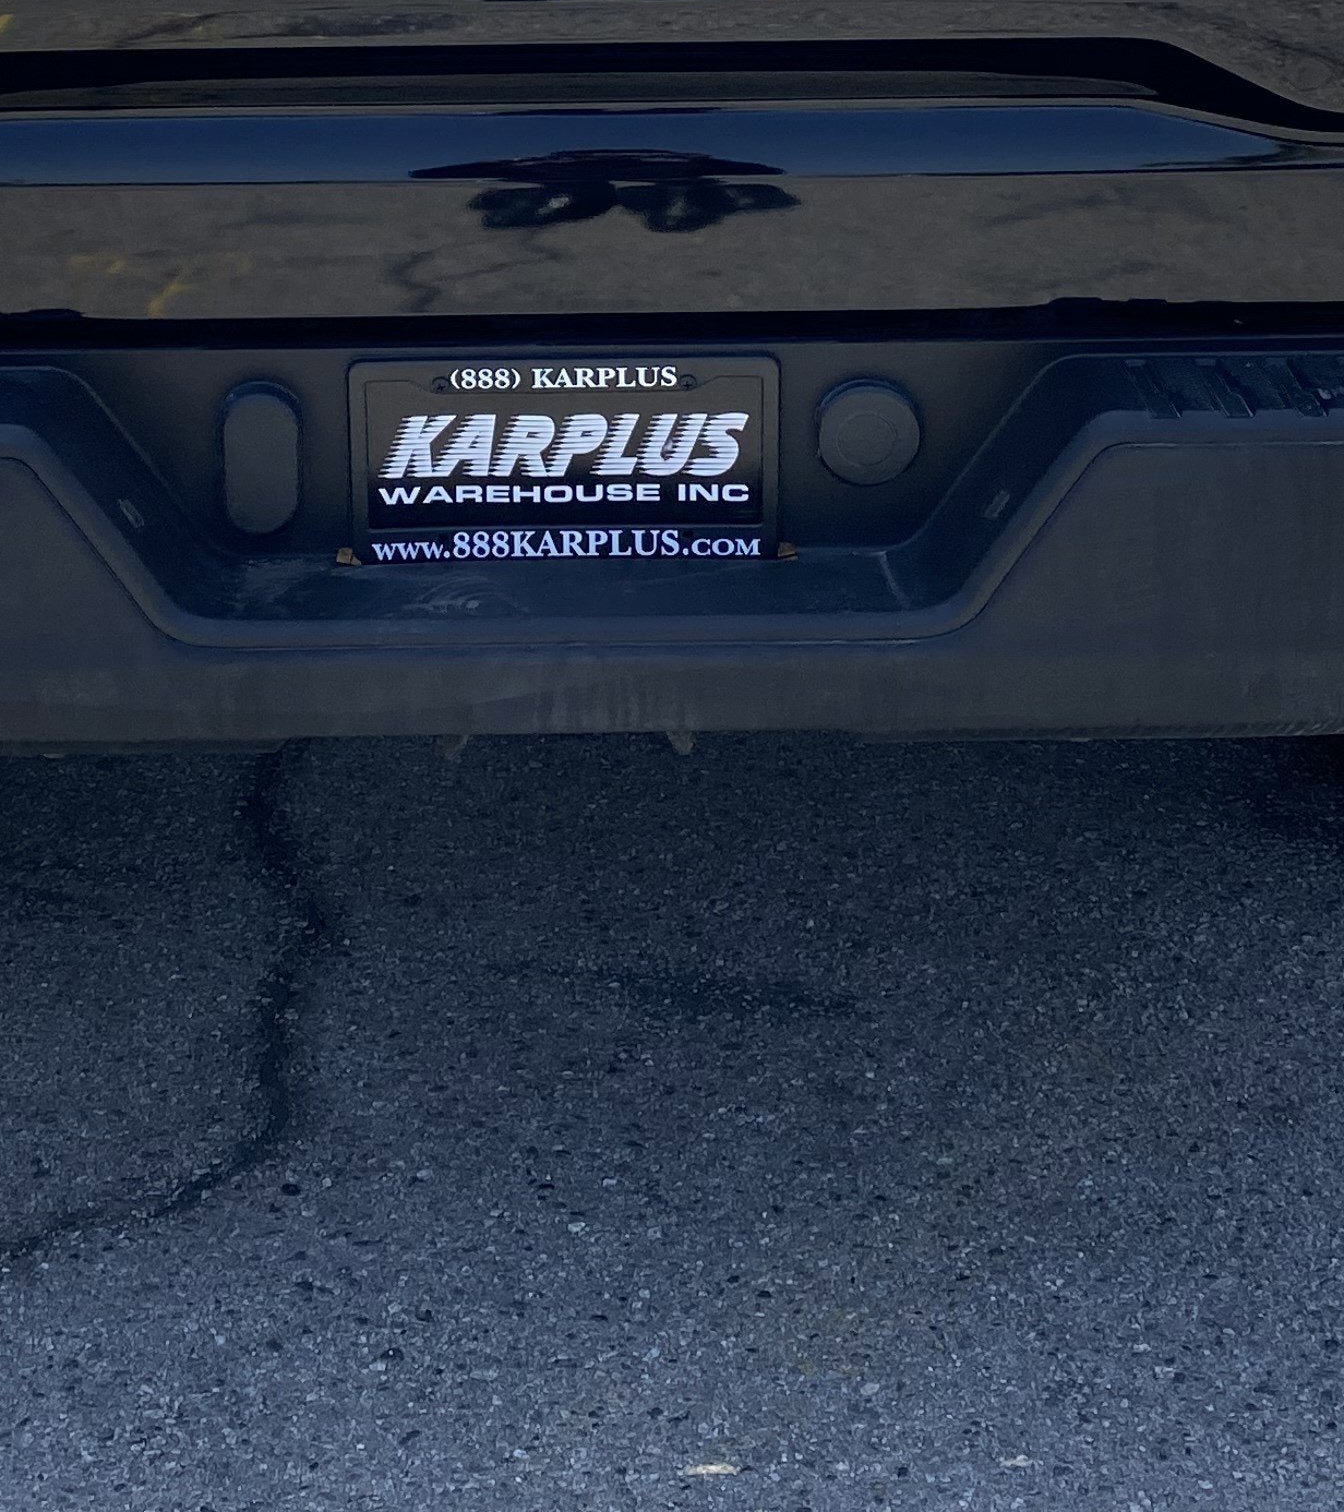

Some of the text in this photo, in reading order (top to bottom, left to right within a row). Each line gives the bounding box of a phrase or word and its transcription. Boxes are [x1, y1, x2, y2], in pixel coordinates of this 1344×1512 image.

[450, 366, 677, 390] (888) KARPLUS
[377, 412, 749, 479] KARPLUS
[378, 484, 749, 505] WAREHOUSE INC
